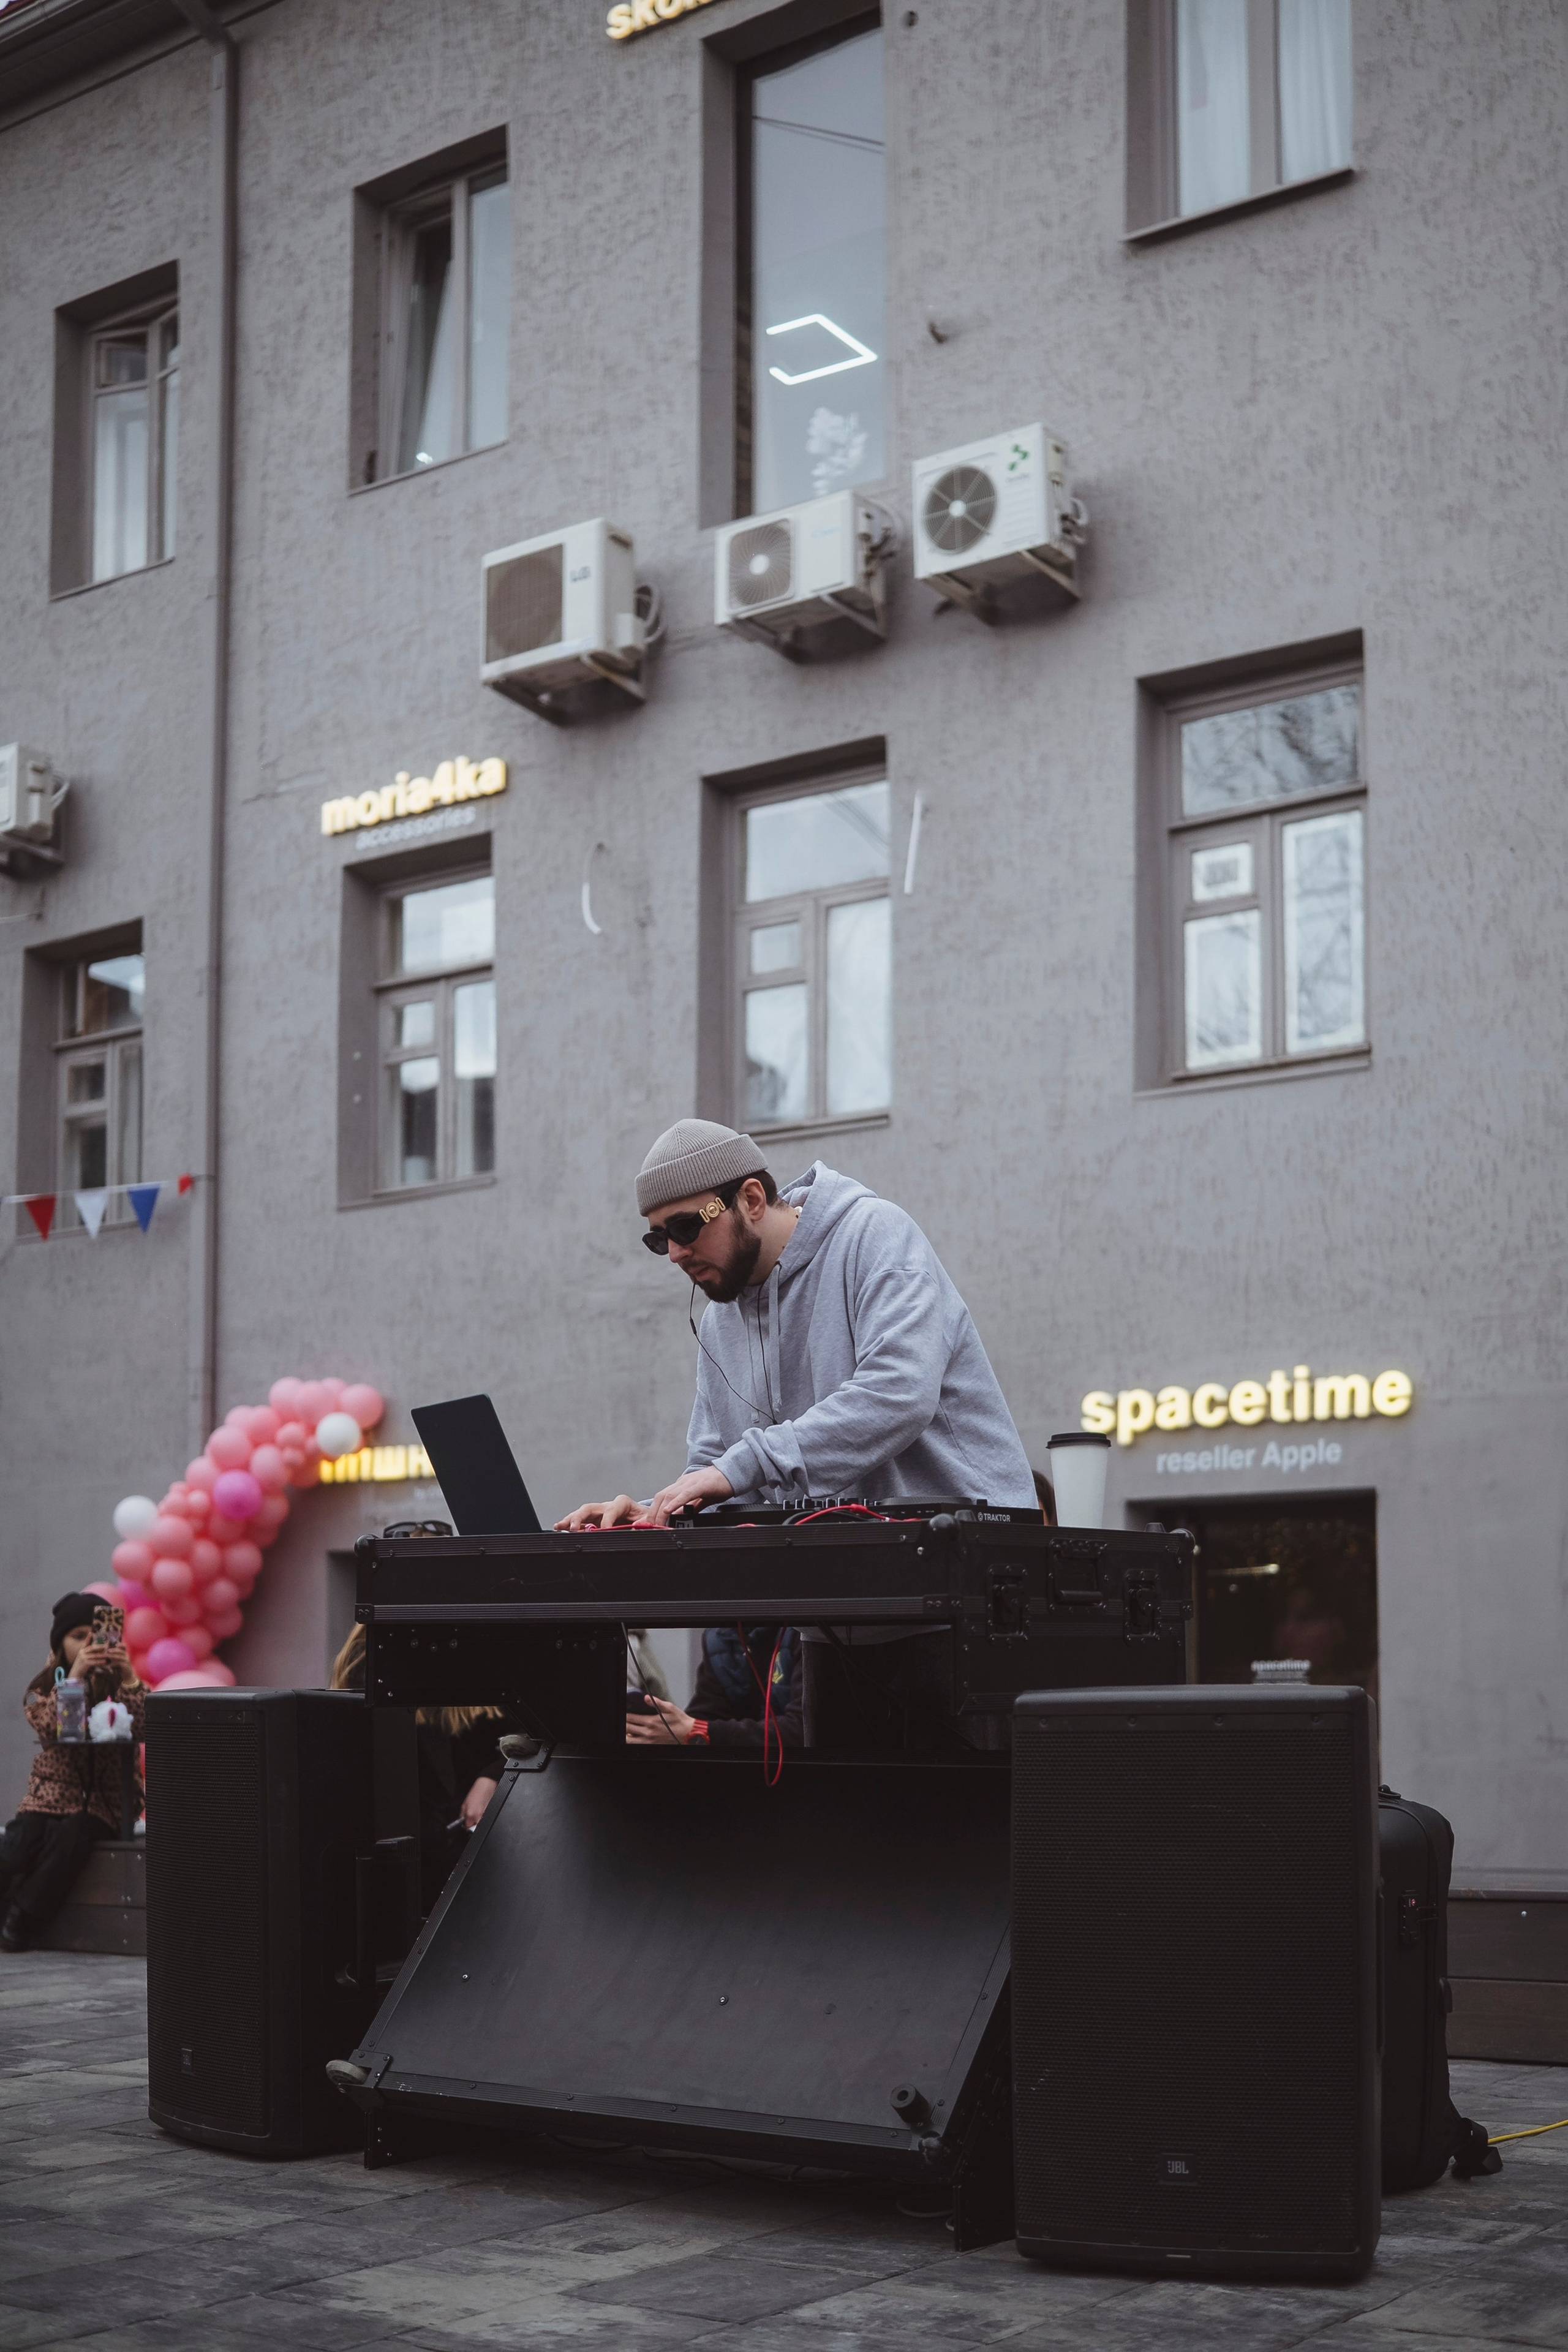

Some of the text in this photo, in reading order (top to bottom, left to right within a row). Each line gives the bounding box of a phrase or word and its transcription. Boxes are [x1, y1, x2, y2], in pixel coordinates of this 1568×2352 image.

[321, 755, 507, 836] moria4ka
[1080, 1365, 1412, 1446] spacetime
[1156, 1438, 1343, 1474] reseller Apple
[983, 1513, 1011, 1522] TRAKTOR
[1167, 2160, 1189, 2174] JBL
